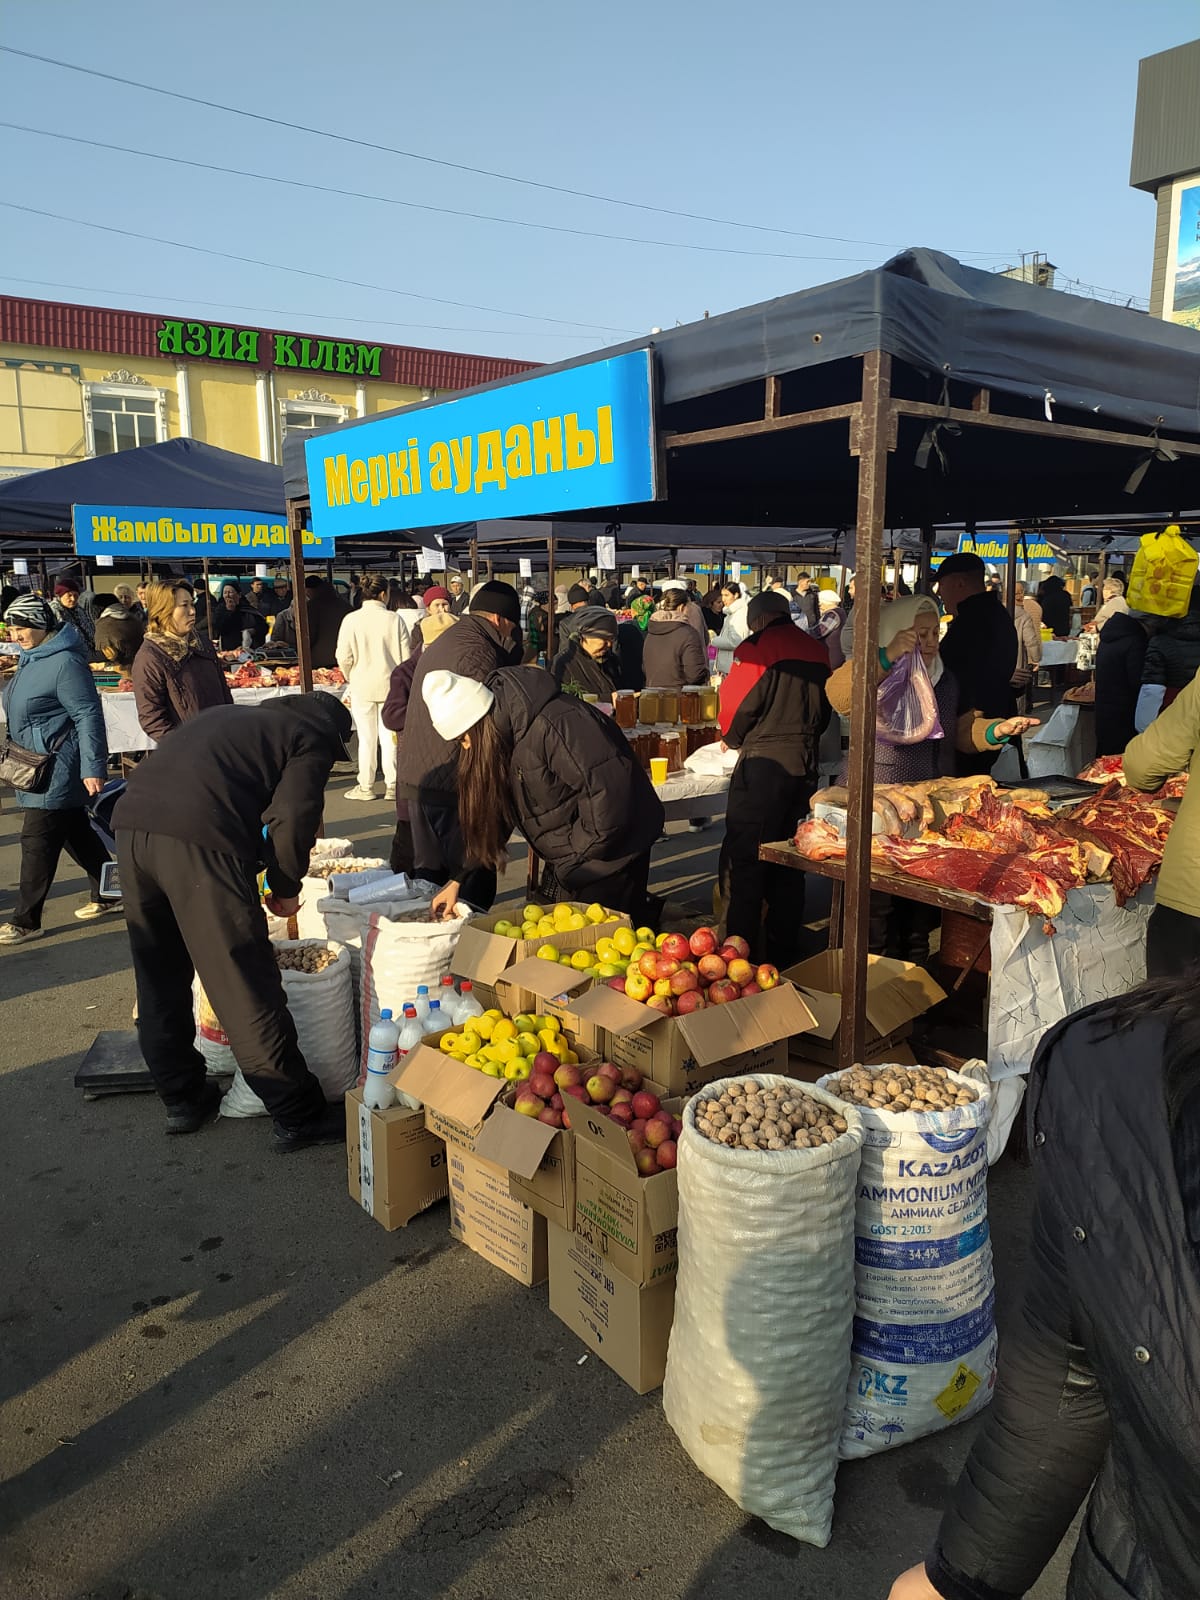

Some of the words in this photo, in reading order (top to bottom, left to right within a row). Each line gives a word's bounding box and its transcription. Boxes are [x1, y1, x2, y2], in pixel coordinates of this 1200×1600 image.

[158, 320, 260, 363] АЗИЯ
[274, 334, 383, 376] КІЛЕМ
[323, 437, 421, 507] Меркі
[429, 406, 613, 494] ауданы
[91, 516, 217, 543] Жамбыл
[859, 1182, 963, 1204] AMMONIUM
[890, 1205, 945, 1219] АММИАК
[870, 1224, 897, 1236] GOST
